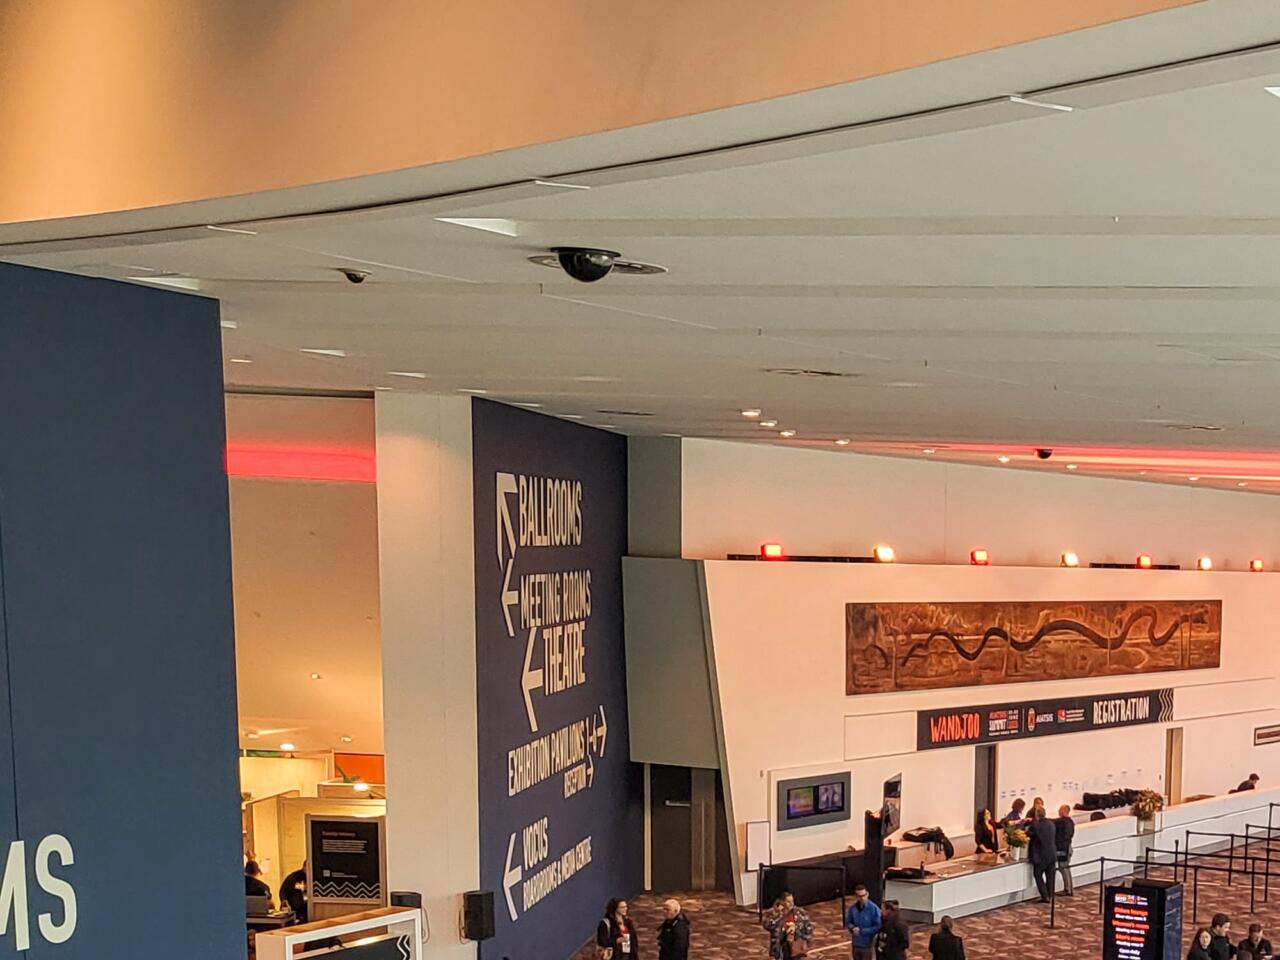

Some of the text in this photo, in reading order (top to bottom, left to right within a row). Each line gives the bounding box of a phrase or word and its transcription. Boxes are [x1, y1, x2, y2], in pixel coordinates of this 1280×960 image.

[519, 474, 583, 547] BALLROOMS
[520, 569, 592, 630] MEETING ROOMS
[543, 620, 586, 696] THEATRE
[930, 712, 981, 743] WANDJOO
[1093, 696, 1150, 725] REGISTRATION
[508, 735, 550, 797] EXHIBITION
[551, 719, 585, 774] PAVILIONS
[523, 816, 548, 871] VOCUS
